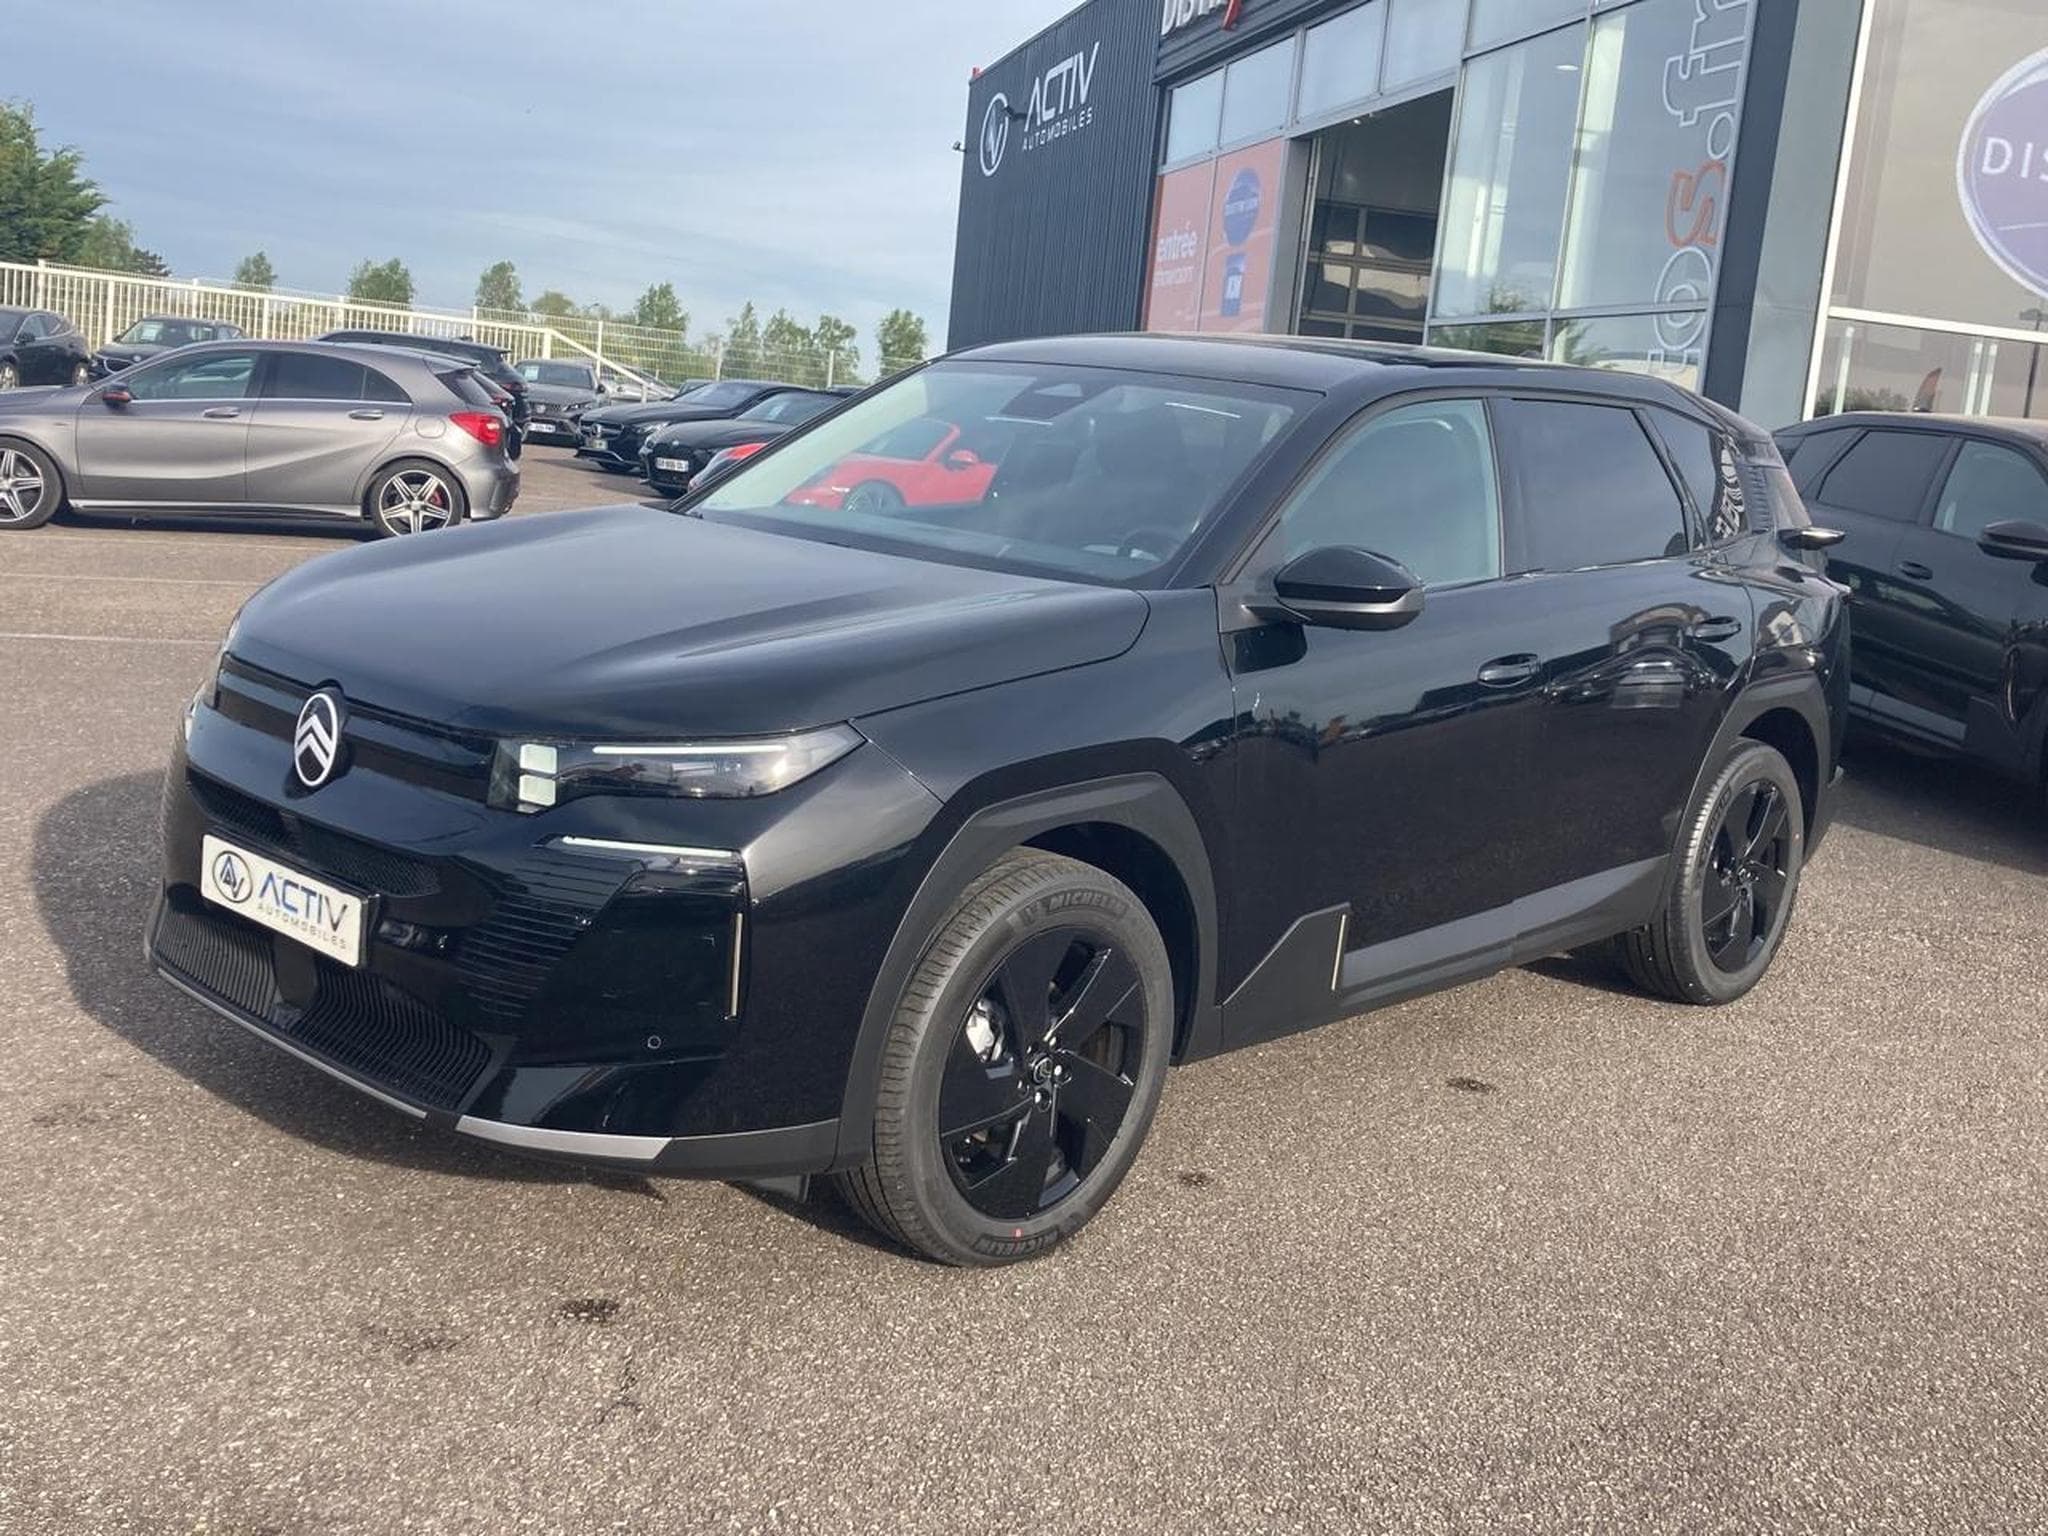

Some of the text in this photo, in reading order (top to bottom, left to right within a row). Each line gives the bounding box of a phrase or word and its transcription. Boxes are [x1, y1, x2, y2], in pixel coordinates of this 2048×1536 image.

[1024, 41, 1100, 132] ACTIV
[1022, 107, 1093, 152] AUTOMOBILES
[256, 903, 347, 950] AUTOMOBILES
[259, 871, 348, 932] ACTIV
